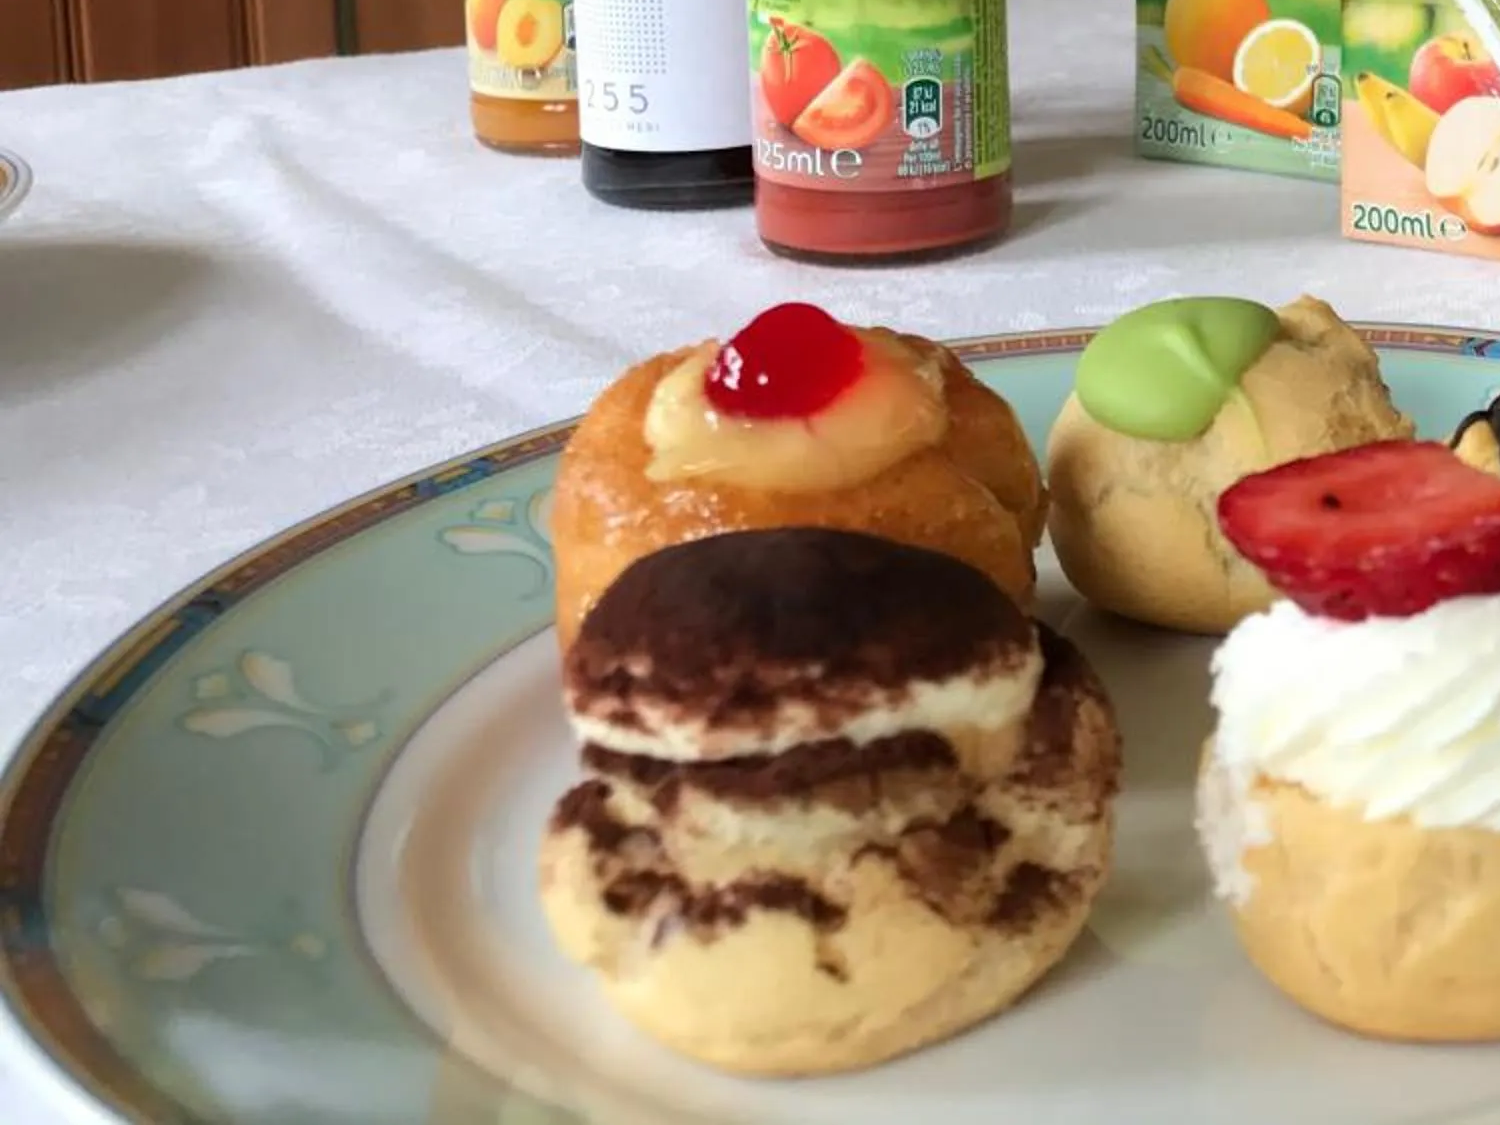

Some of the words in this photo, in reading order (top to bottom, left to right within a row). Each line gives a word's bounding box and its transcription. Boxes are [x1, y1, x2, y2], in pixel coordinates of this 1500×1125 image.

[1142, 116, 1207, 149] 200ml
[755, 139, 824, 176] 125ml
[1353, 204, 1435, 240] 200ml
